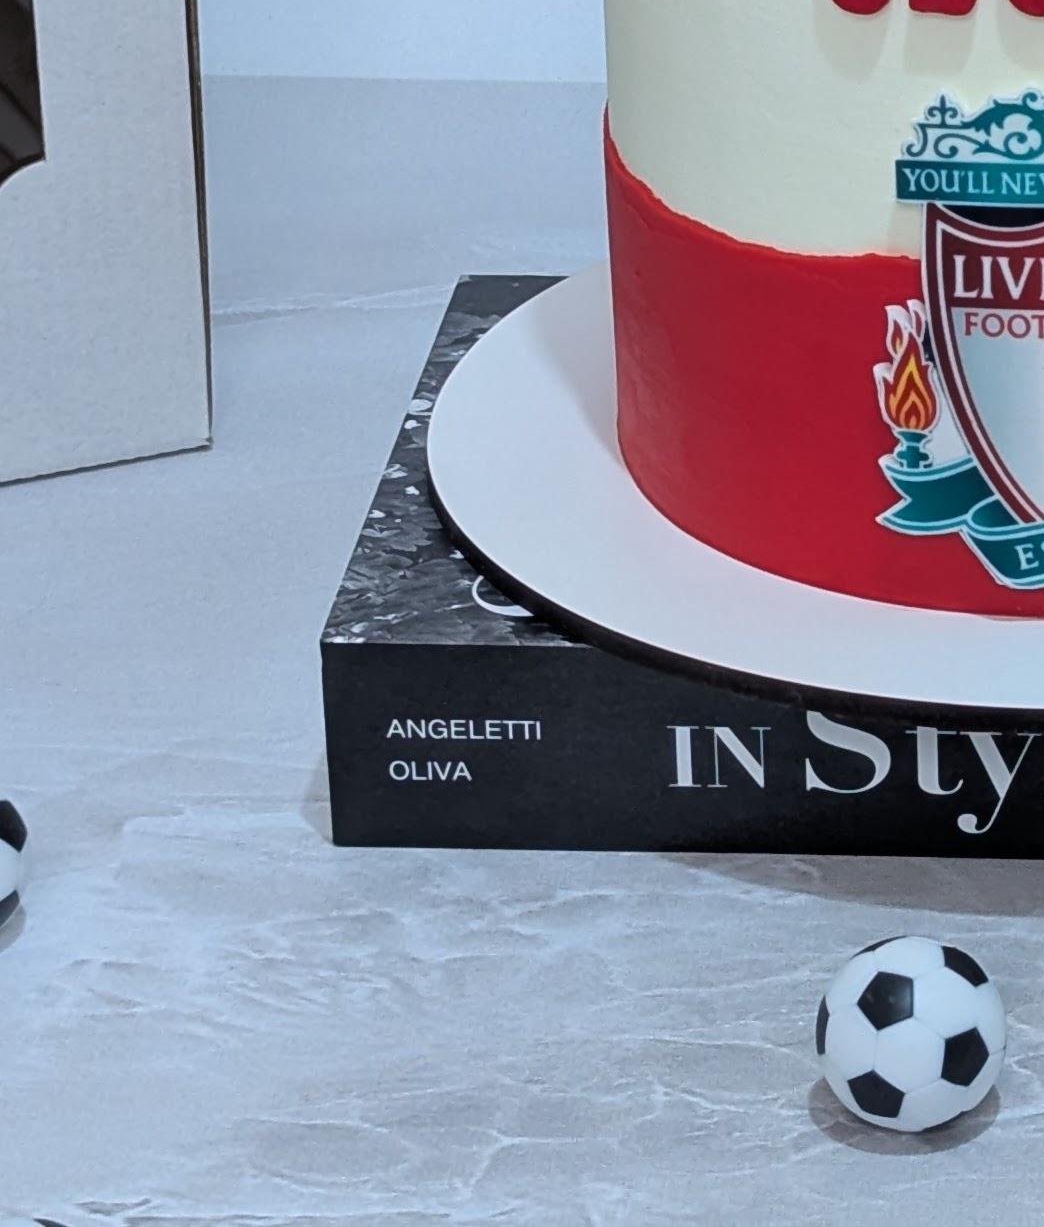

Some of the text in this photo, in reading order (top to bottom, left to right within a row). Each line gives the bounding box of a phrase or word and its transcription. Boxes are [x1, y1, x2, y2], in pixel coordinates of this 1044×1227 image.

[902, 168, 994, 195] YOU'LL
[386, 718, 542, 741] ANGELETTI
[667, 725, 772, 789] IN
[389, 760, 473, 782] OLIVA
